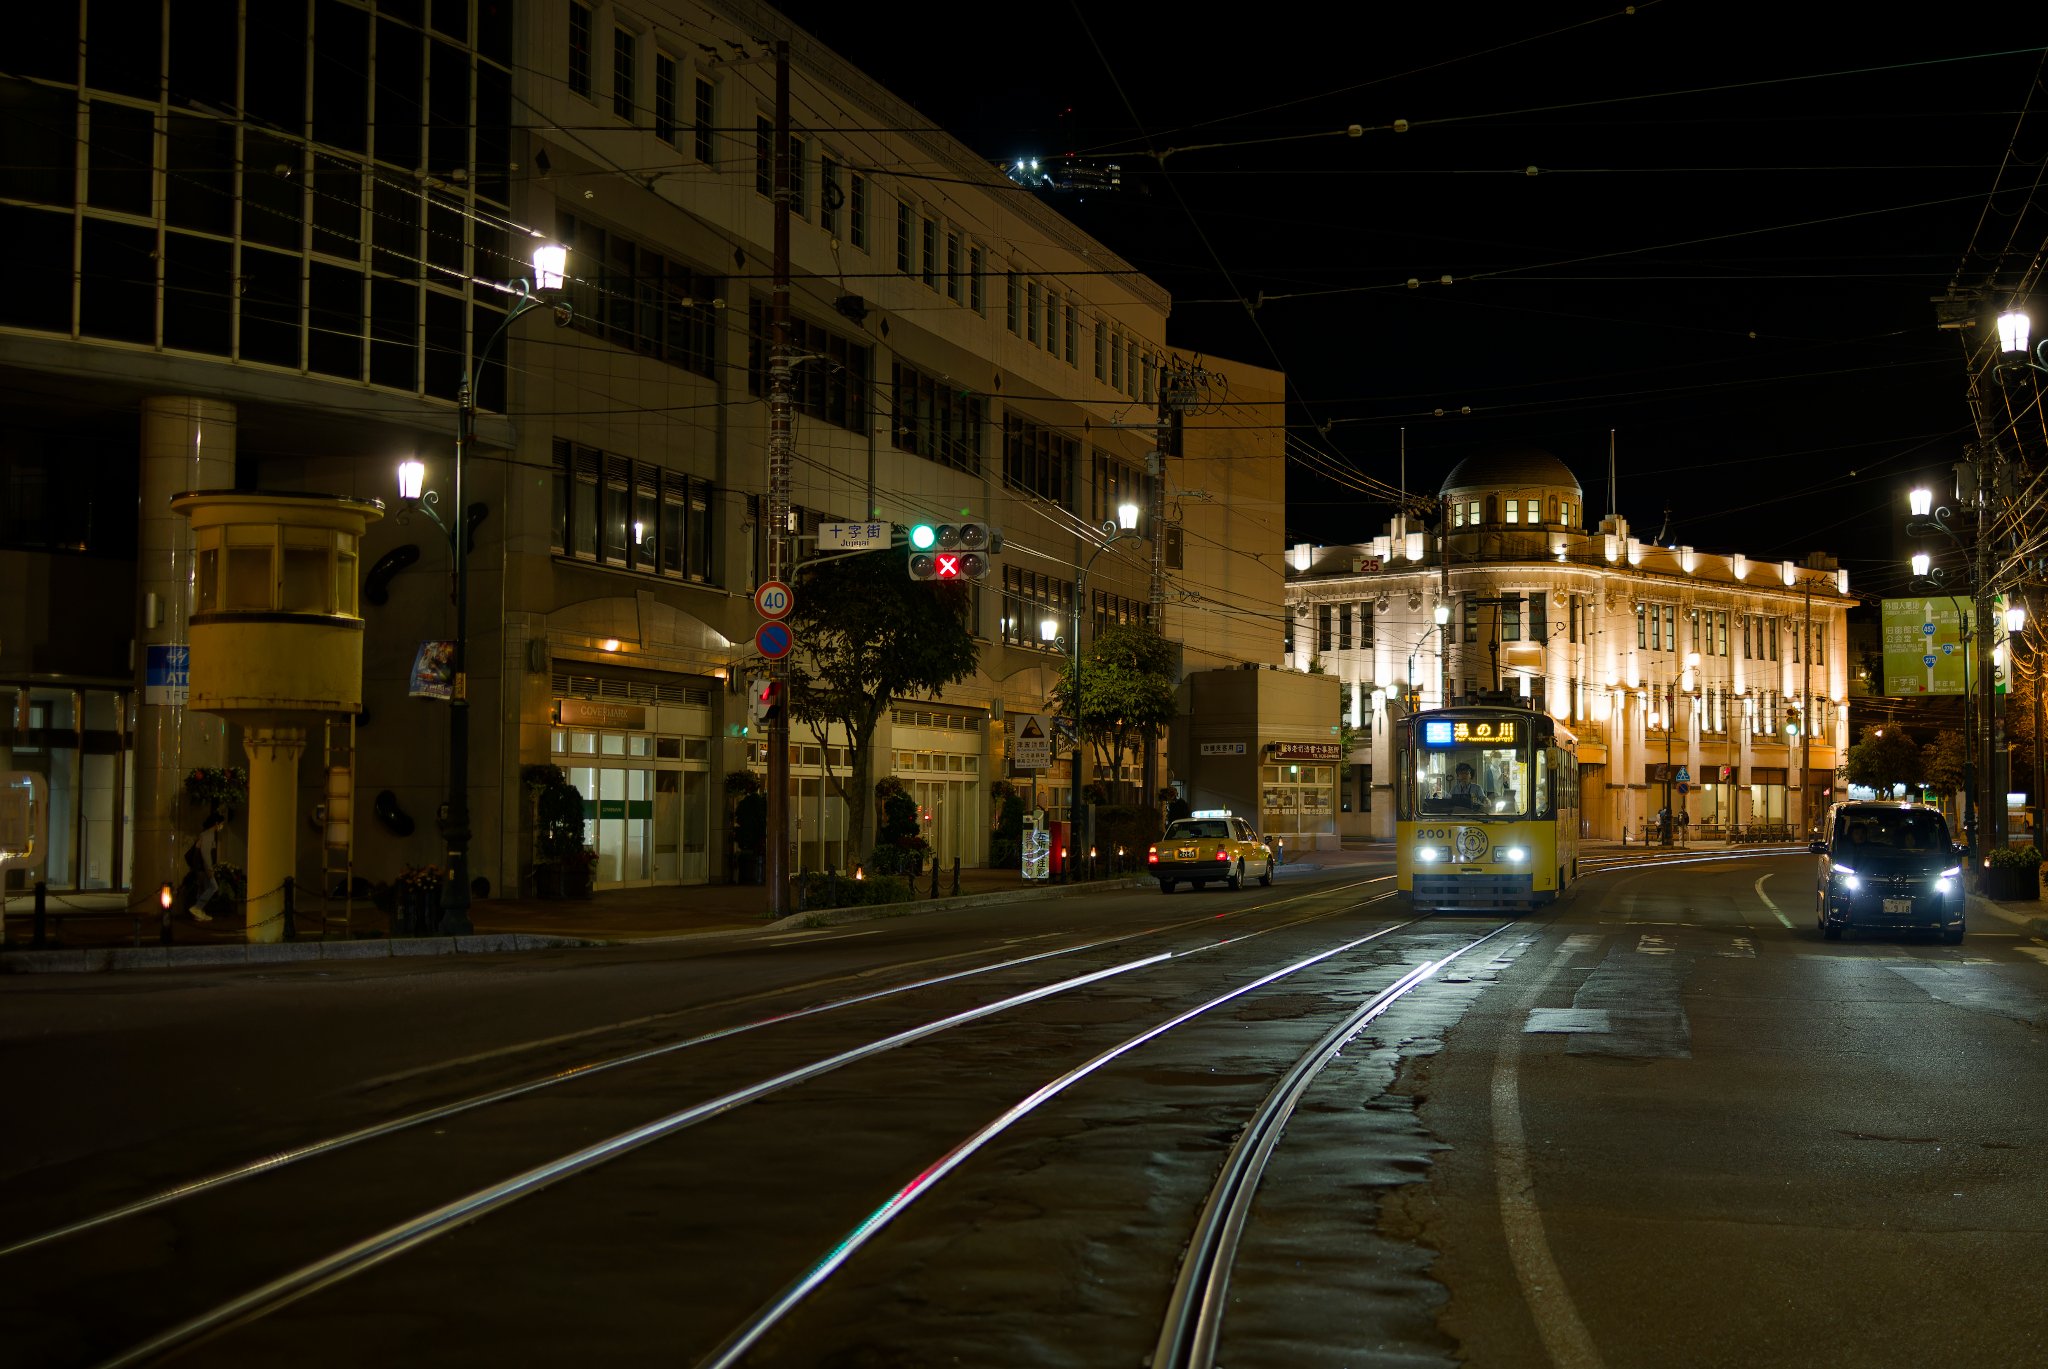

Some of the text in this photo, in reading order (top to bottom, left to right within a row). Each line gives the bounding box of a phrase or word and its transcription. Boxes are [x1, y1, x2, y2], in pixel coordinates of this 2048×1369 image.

[829, 524, 881, 540] 十字街
[1361, 560, 1379, 572] 25
[764, 592, 785, 609] 40
[580, 705, 629, 719] COVERMARK
[1454, 722, 1514, 738] 湯の川
[1417, 829, 1452, 839] 2001
